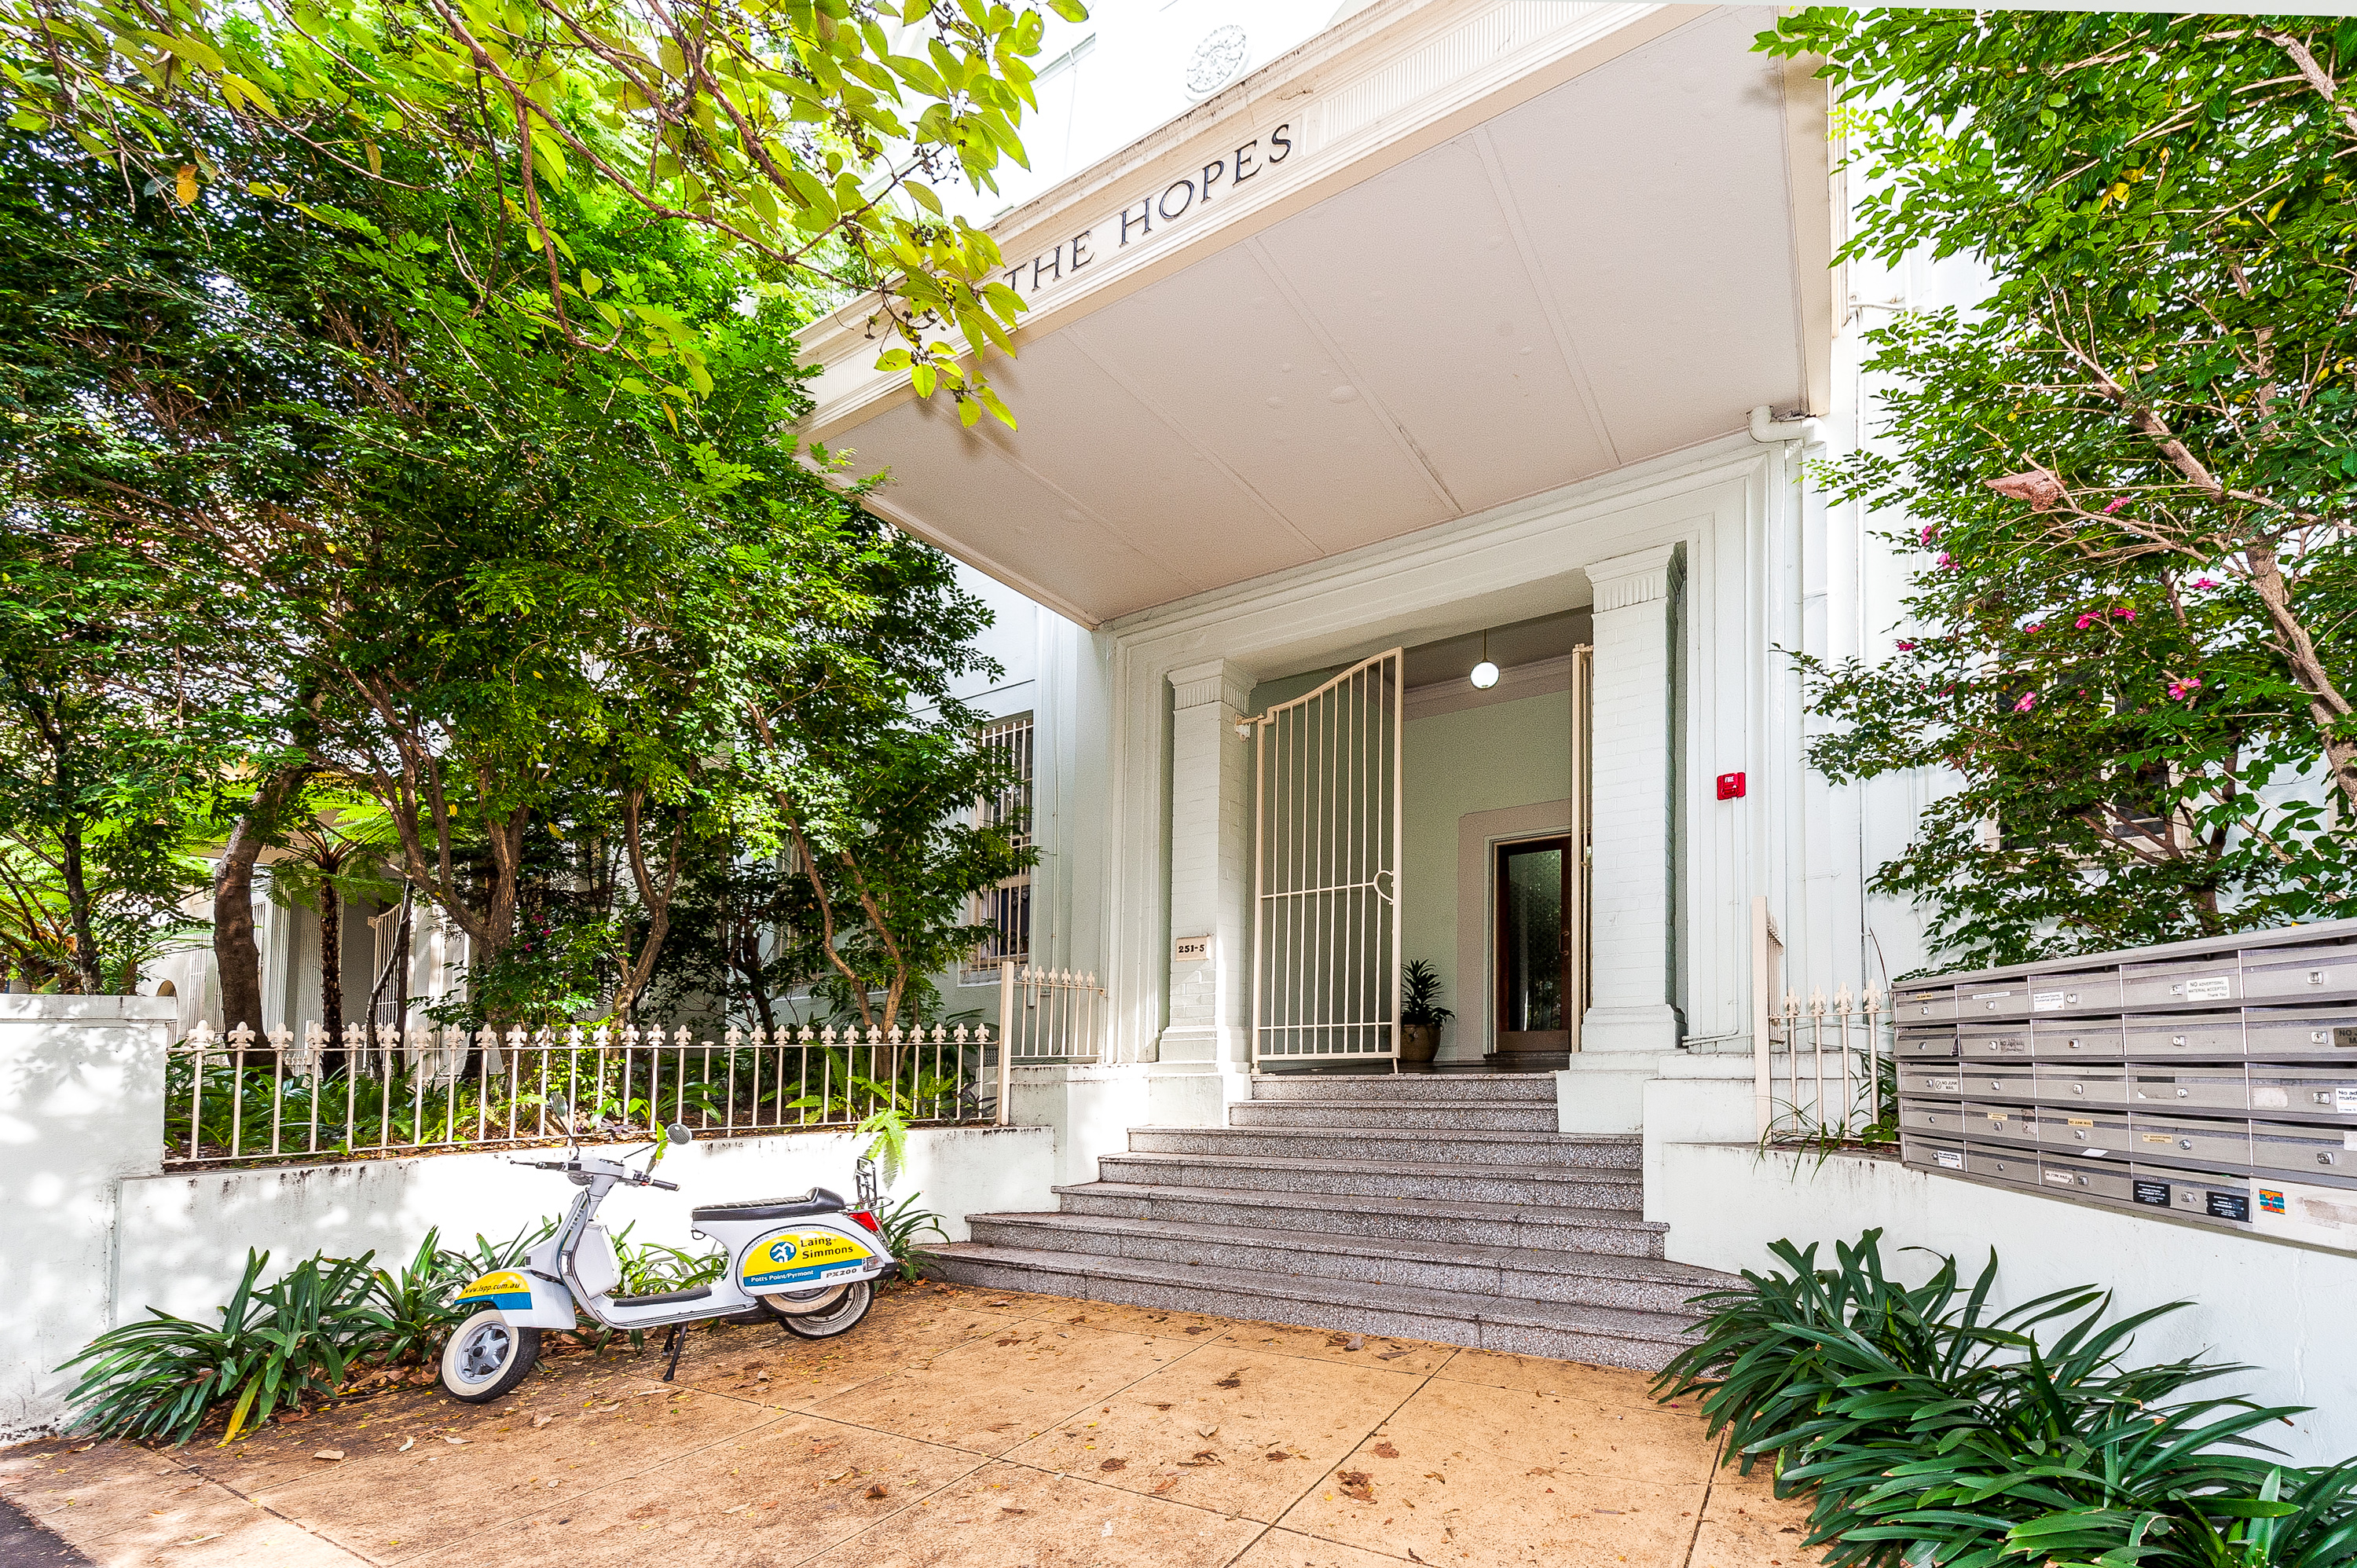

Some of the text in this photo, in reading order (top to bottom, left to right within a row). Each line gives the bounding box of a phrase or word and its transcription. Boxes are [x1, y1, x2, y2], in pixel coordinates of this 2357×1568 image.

[1003, 124, 1292, 293] THE HOPES
[1178, 944, 1205, 953] 251-5
[802, 1246, 853, 1259] Simmons
[826, 1268, 857, 1278] PX200
[464, 1283, 520, 1293] www.lspp.com.au
